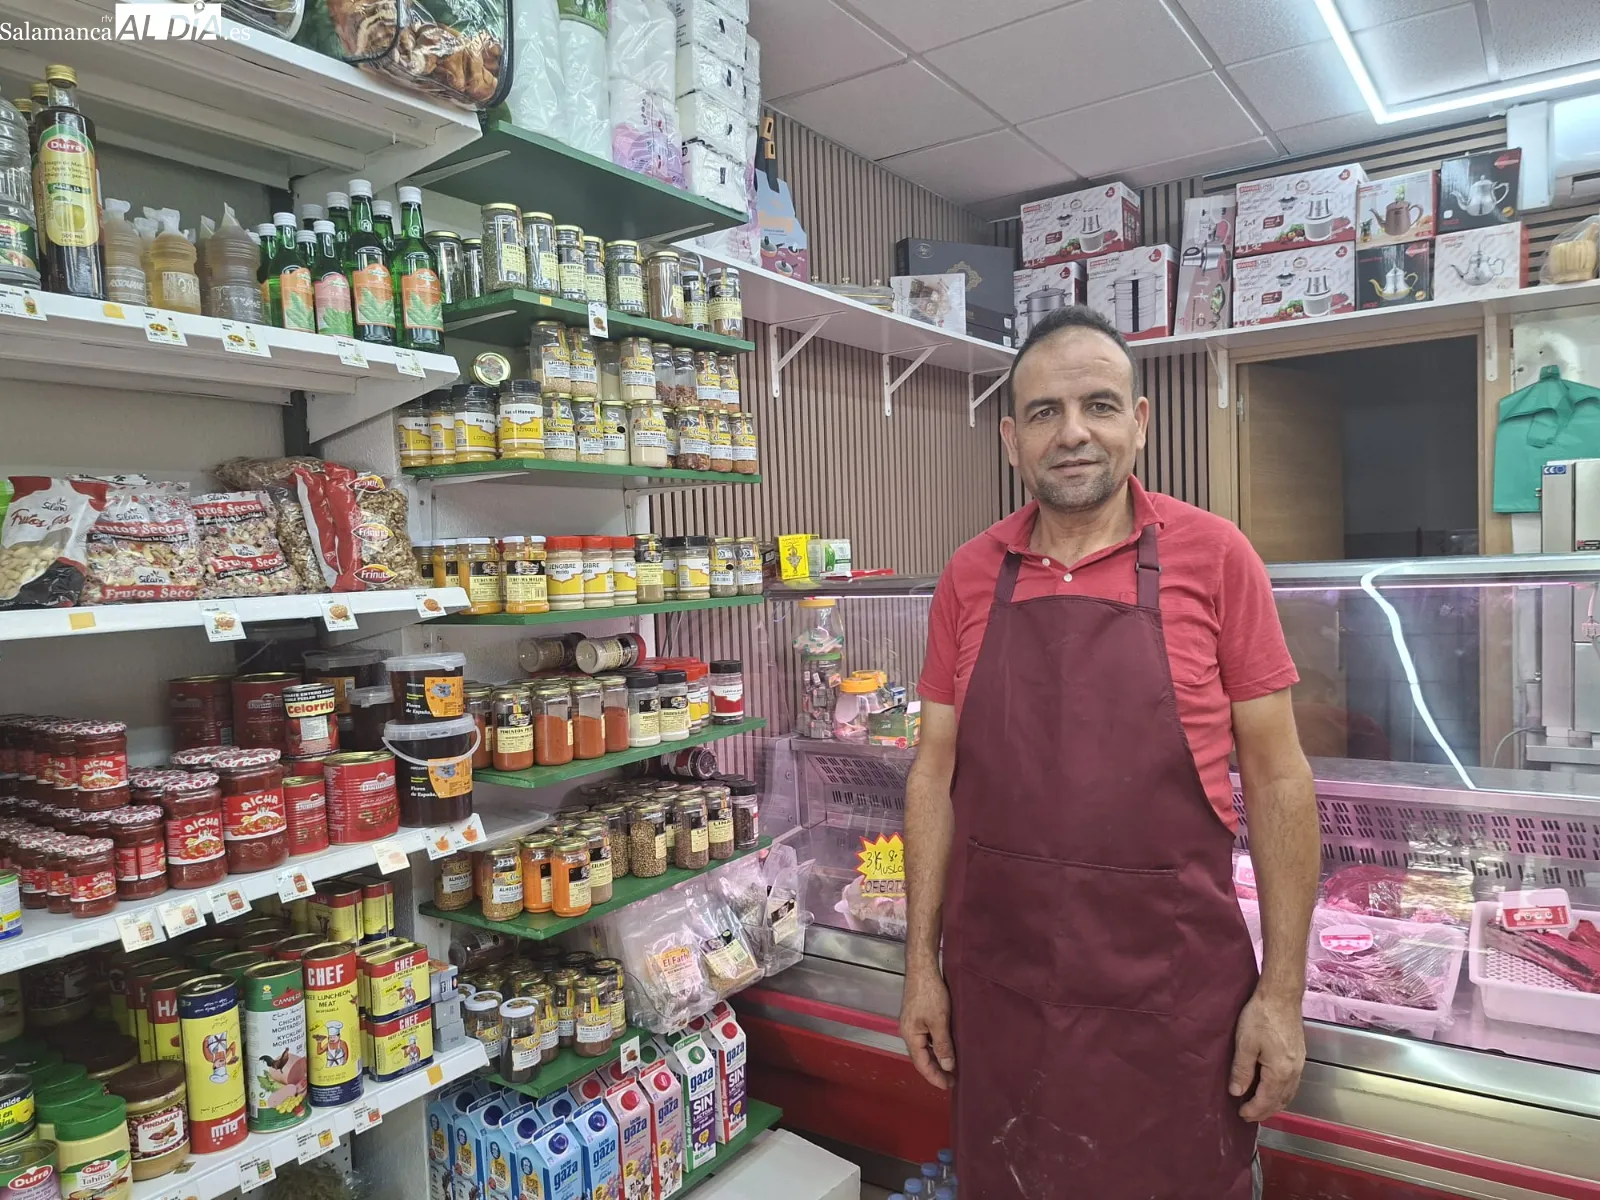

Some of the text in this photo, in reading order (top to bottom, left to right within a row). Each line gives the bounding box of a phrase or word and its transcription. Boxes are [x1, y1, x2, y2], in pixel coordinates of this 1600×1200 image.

[50, 140, 83, 152] Durra
[226, 503, 262, 513] Secos
[98, 523, 184, 535] rutos Secos
[361, 569, 389, 579] Frinuts
[105, 587, 194, 599] Frutos Seco
[287, 701, 334, 714] Celorrio
[240, 794, 279, 811] AICHA
[184, 816, 219, 833] AICHA
[395, 955, 415, 972] CHEF
[307, 963, 345, 987] CHEF
[393, 967, 415, 979] LUNCHEON
[317, 988, 351, 1001] LUNCHEON
[318, 1000, 336, 1008] MEAT
[272, 1019, 305, 1034] MORTADELL
[399, 1013, 419, 1029] CHEF
[277, 1028, 302, 1041] KYCKLIN
[397, 1025, 420, 1037] LUNCHEON
[272, 1033, 305, 1048] MORTADELL
[726, 1041, 745, 1067] gaza
[690, 1066, 714, 1093] gaza
[728, 1065, 745, 1088] SIN
[658, 1098, 679, 1124] gaza
[693, 1092, 713, 1115] SIN
[3, 1110, 13, 1118] en
[142, 1112, 180, 1130] PINDAKAAS
[624, 1118, 647, 1144] gaza
[593, 1139, 616, 1168] gaza
[86, 1161, 110, 1174] Durra
[554, 1160, 578, 1190] gaza
[14, 1169, 49, 1188] Durra
